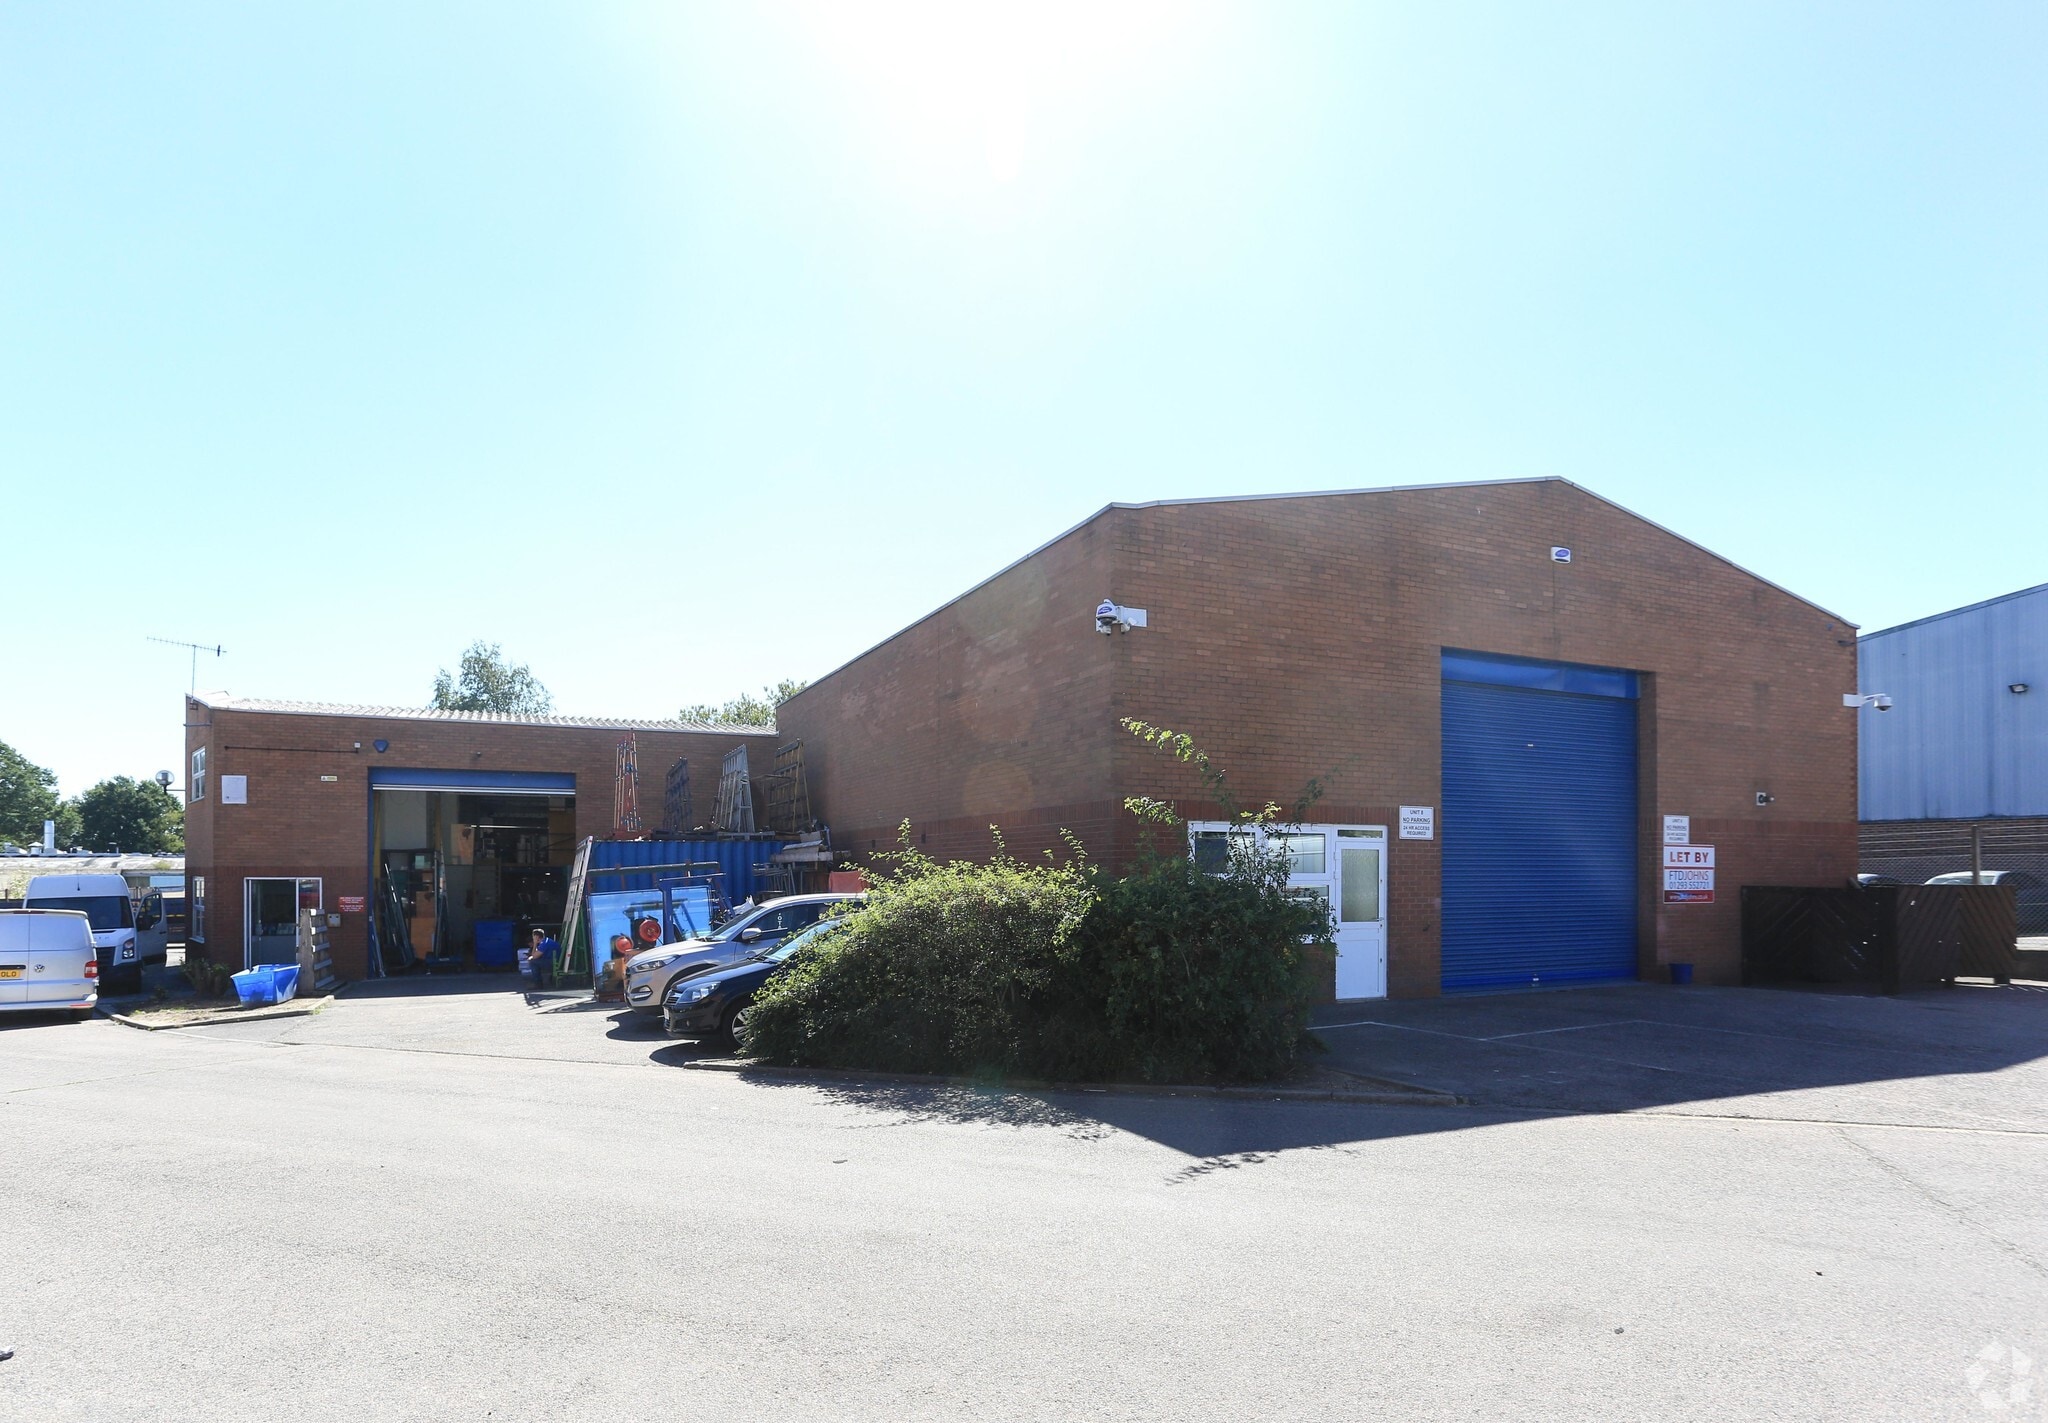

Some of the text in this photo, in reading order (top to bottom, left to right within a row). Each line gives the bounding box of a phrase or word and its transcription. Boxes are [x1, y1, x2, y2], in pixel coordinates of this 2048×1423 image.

[1670, 851, 1709, 863] LET BY
[1669, 881, 1688, 890] 01293
